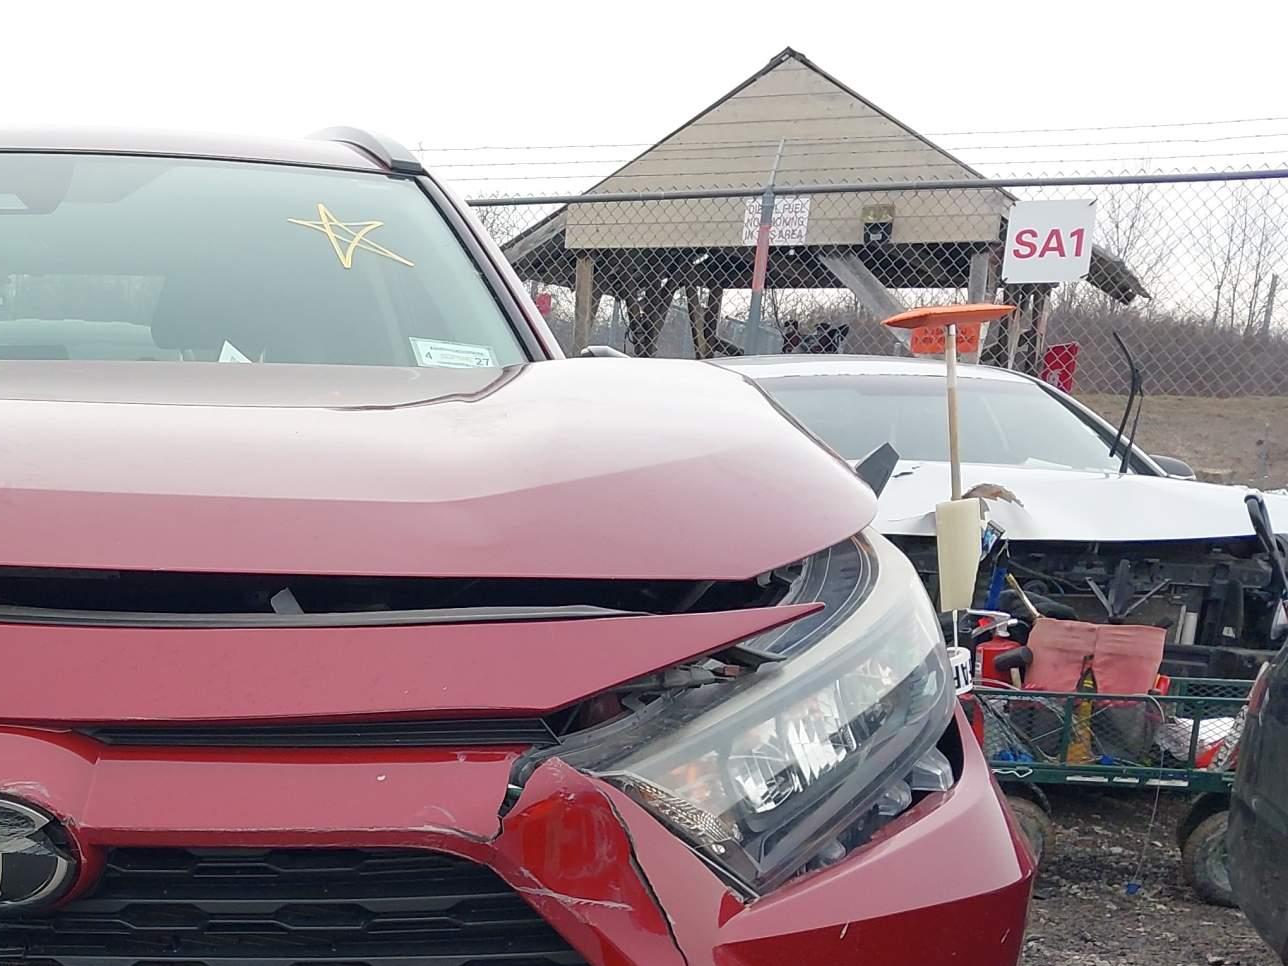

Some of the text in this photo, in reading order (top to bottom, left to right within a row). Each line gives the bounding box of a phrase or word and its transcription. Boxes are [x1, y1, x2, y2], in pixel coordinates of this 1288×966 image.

[748, 203, 806, 215] DIEL FUEL
[746, 216, 804, 227] NO OKING
[778, 229, 803, 240] AREA
[1013, 228, 1085, 259] SA1
[475, 357, 489, 366] 27
